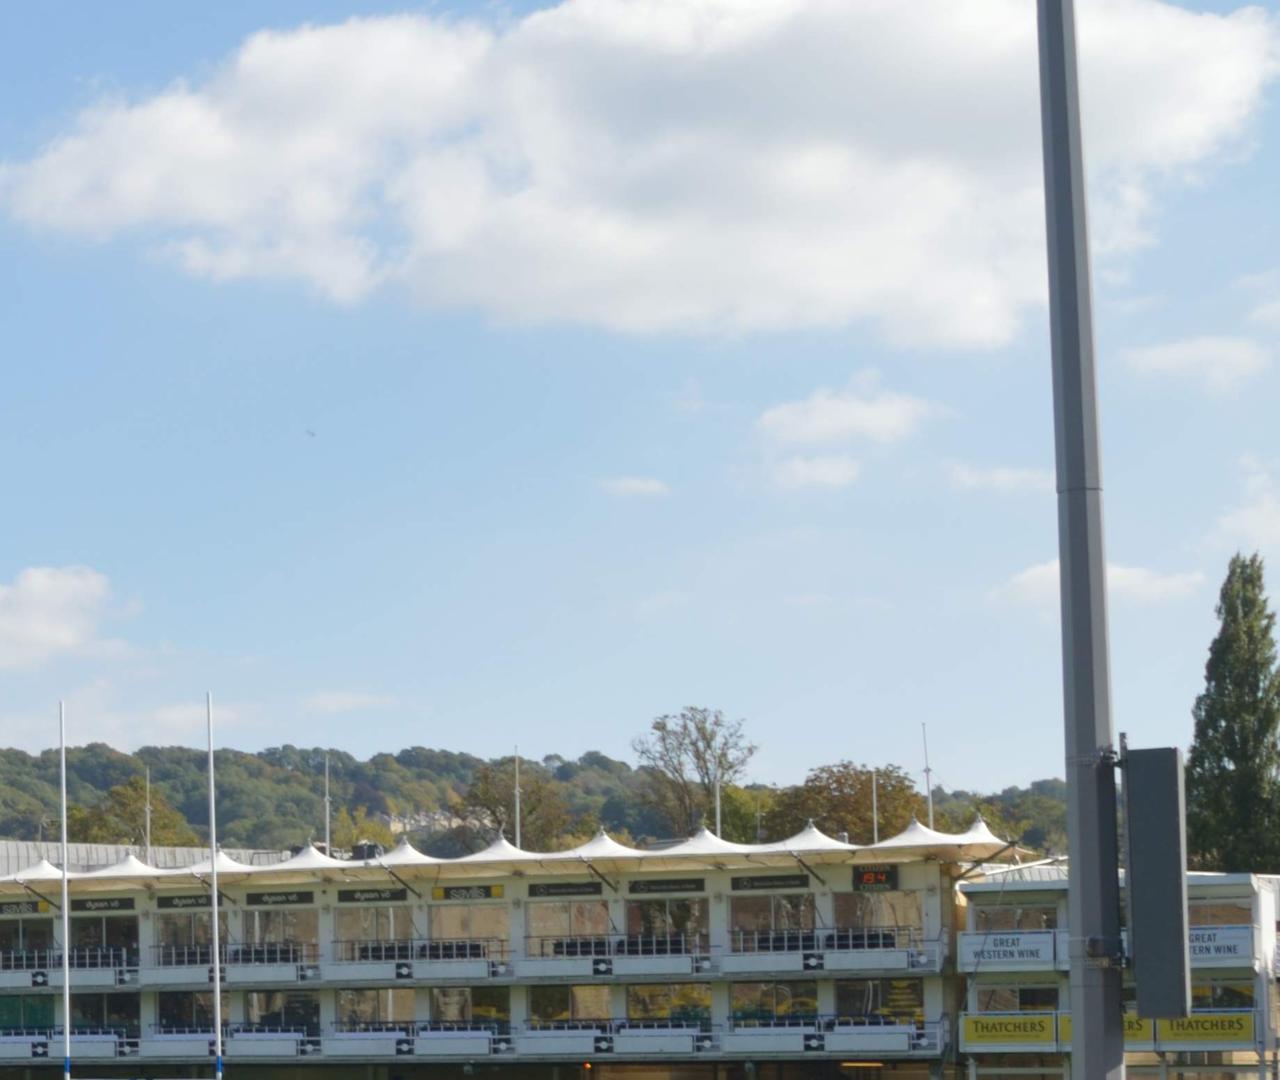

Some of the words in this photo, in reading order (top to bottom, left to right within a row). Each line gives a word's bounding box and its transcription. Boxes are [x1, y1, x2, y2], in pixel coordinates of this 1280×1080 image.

[993, 938, 1020, 948] GREAT
[973, 950, 1014, 960] WESTERN
[1017, 949, 1040, 959] WINE
[1214, 944, 1238, 955] WINE
[972, 1020, 1045, 1033] THATCHERS
